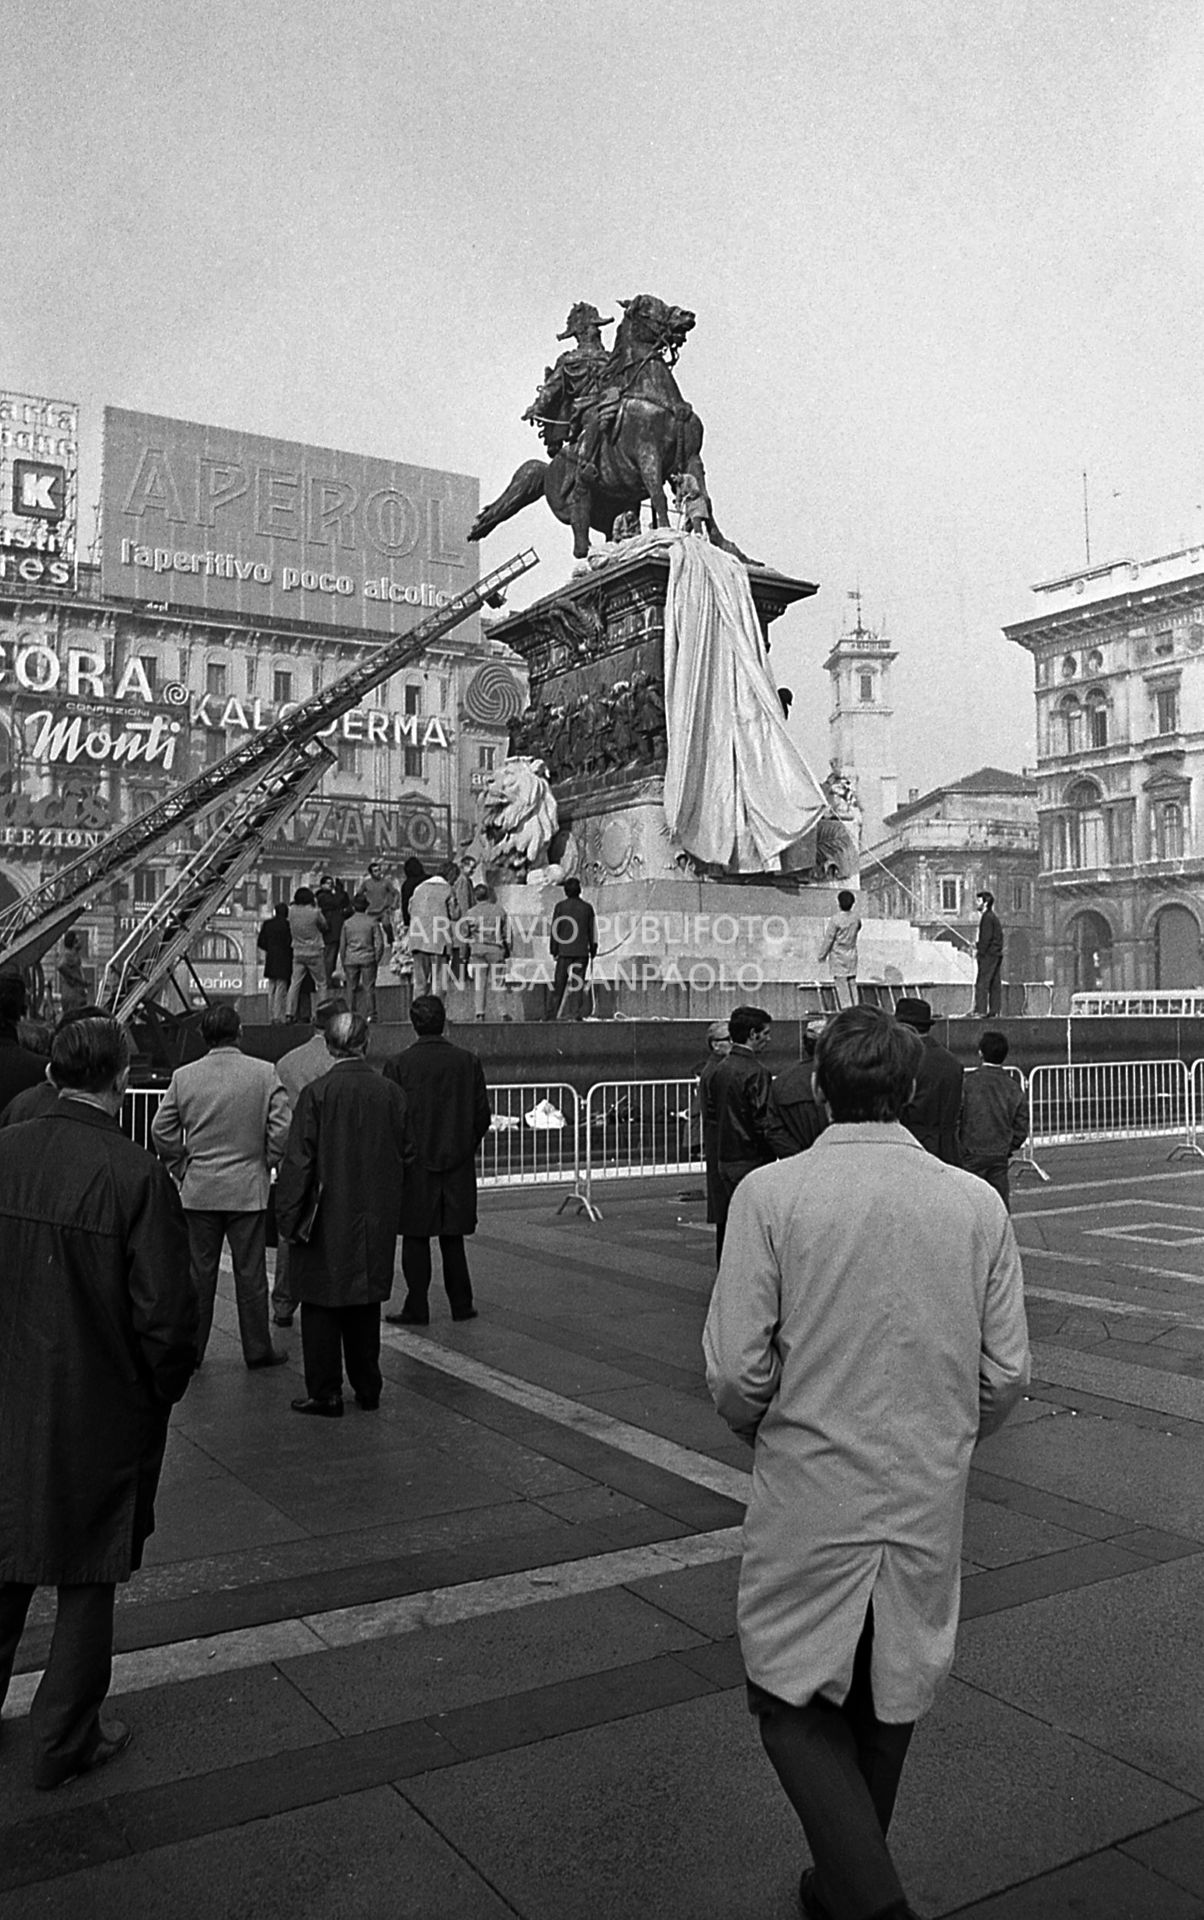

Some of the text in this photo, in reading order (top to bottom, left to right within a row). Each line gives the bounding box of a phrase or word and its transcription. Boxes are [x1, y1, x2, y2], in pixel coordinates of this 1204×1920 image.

[22, 472, 58, 511] K
[121, 448, 466, 568] APEROL
[120, 538, 272, 584] l'aperitivo
[282, 566, 354, 595] poco
[0, 644, 153, 703] ORA
[65, 702, 150, 717] CONFEZIONI
[190, 692, 448, 748] KALERMA
[24, 711, 180, 770] Monti
